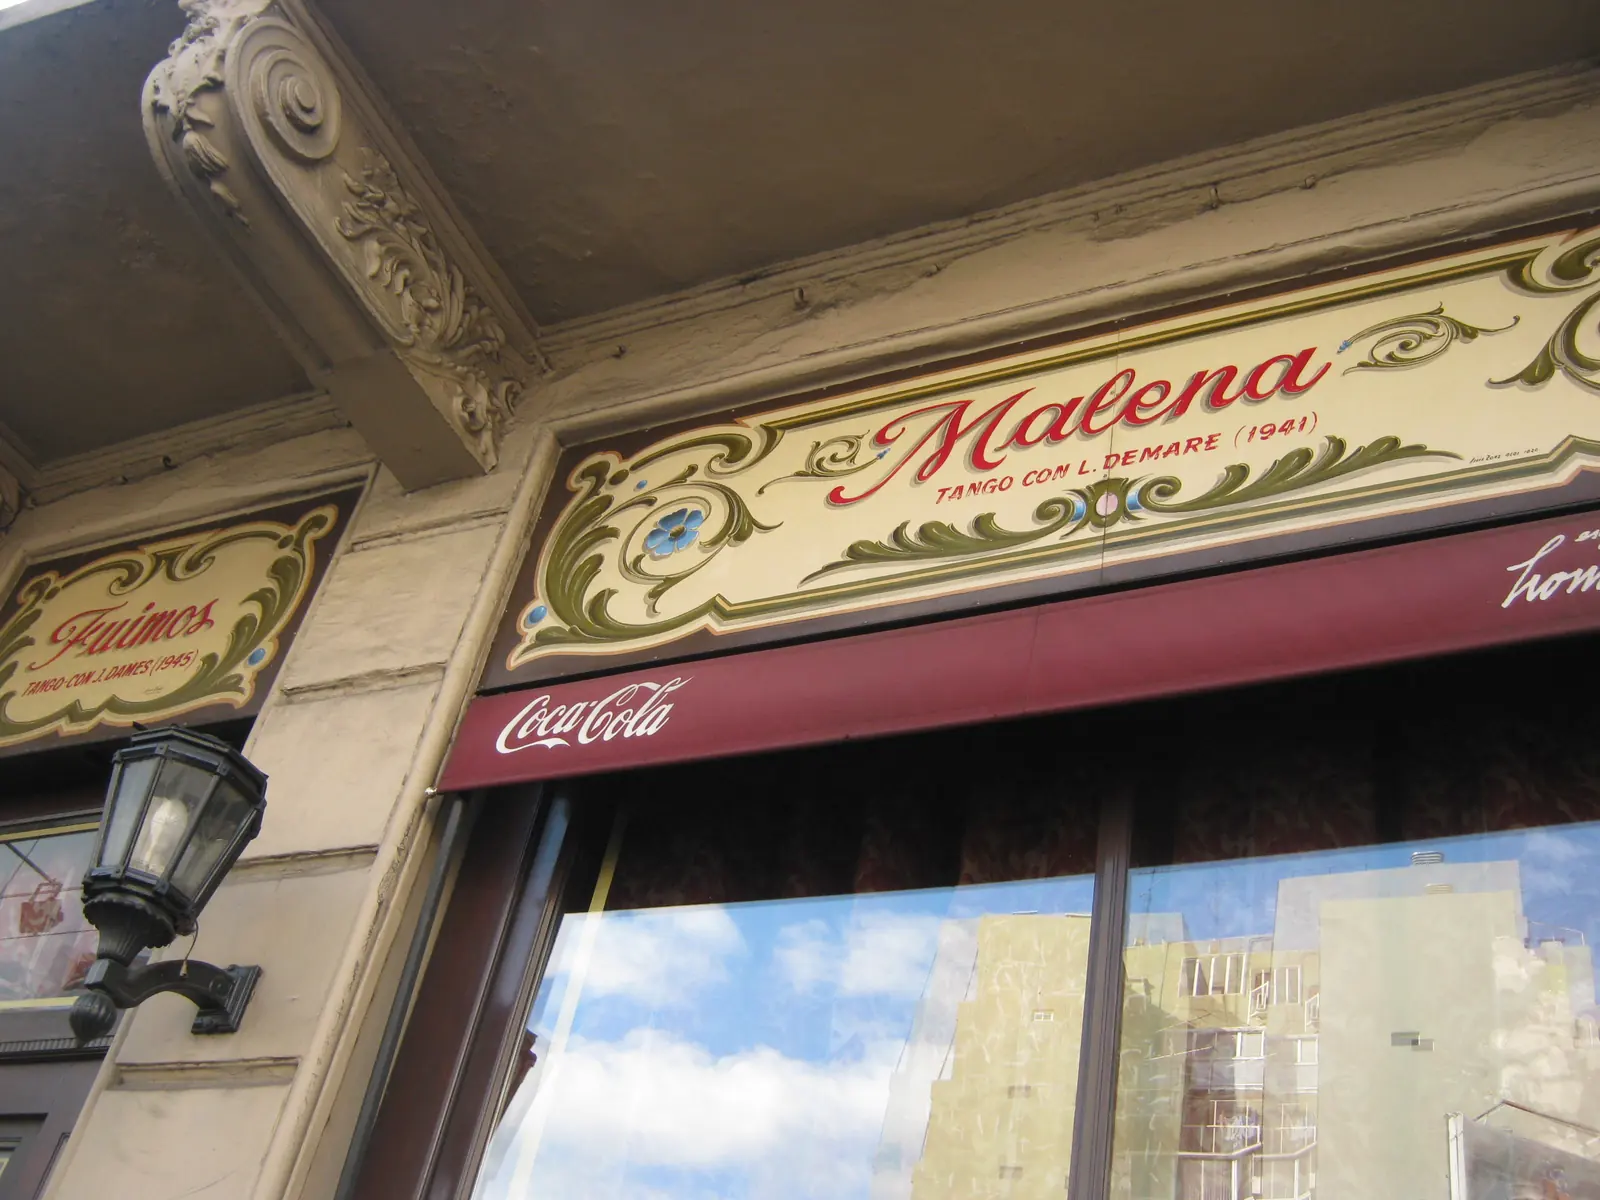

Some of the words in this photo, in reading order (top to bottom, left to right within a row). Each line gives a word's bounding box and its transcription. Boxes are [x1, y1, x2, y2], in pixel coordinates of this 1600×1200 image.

[826, 346, 1332, 506] Malena
[936, 475, 1014, 505] TANGO
[1021, 463, 1071, 487] CON
[1077, 459, 1097, 476] L.
[1103, 432, 1221, 470] DEMARE
[1234, 411, 1318, 450] (1941)
[27, 598, 219, 670] Fuimos
[104, 659, 153, 681] DAMES
[149, 649, 199, 677] (1945)
[496, 676, 694, 754] Coca-Cola
